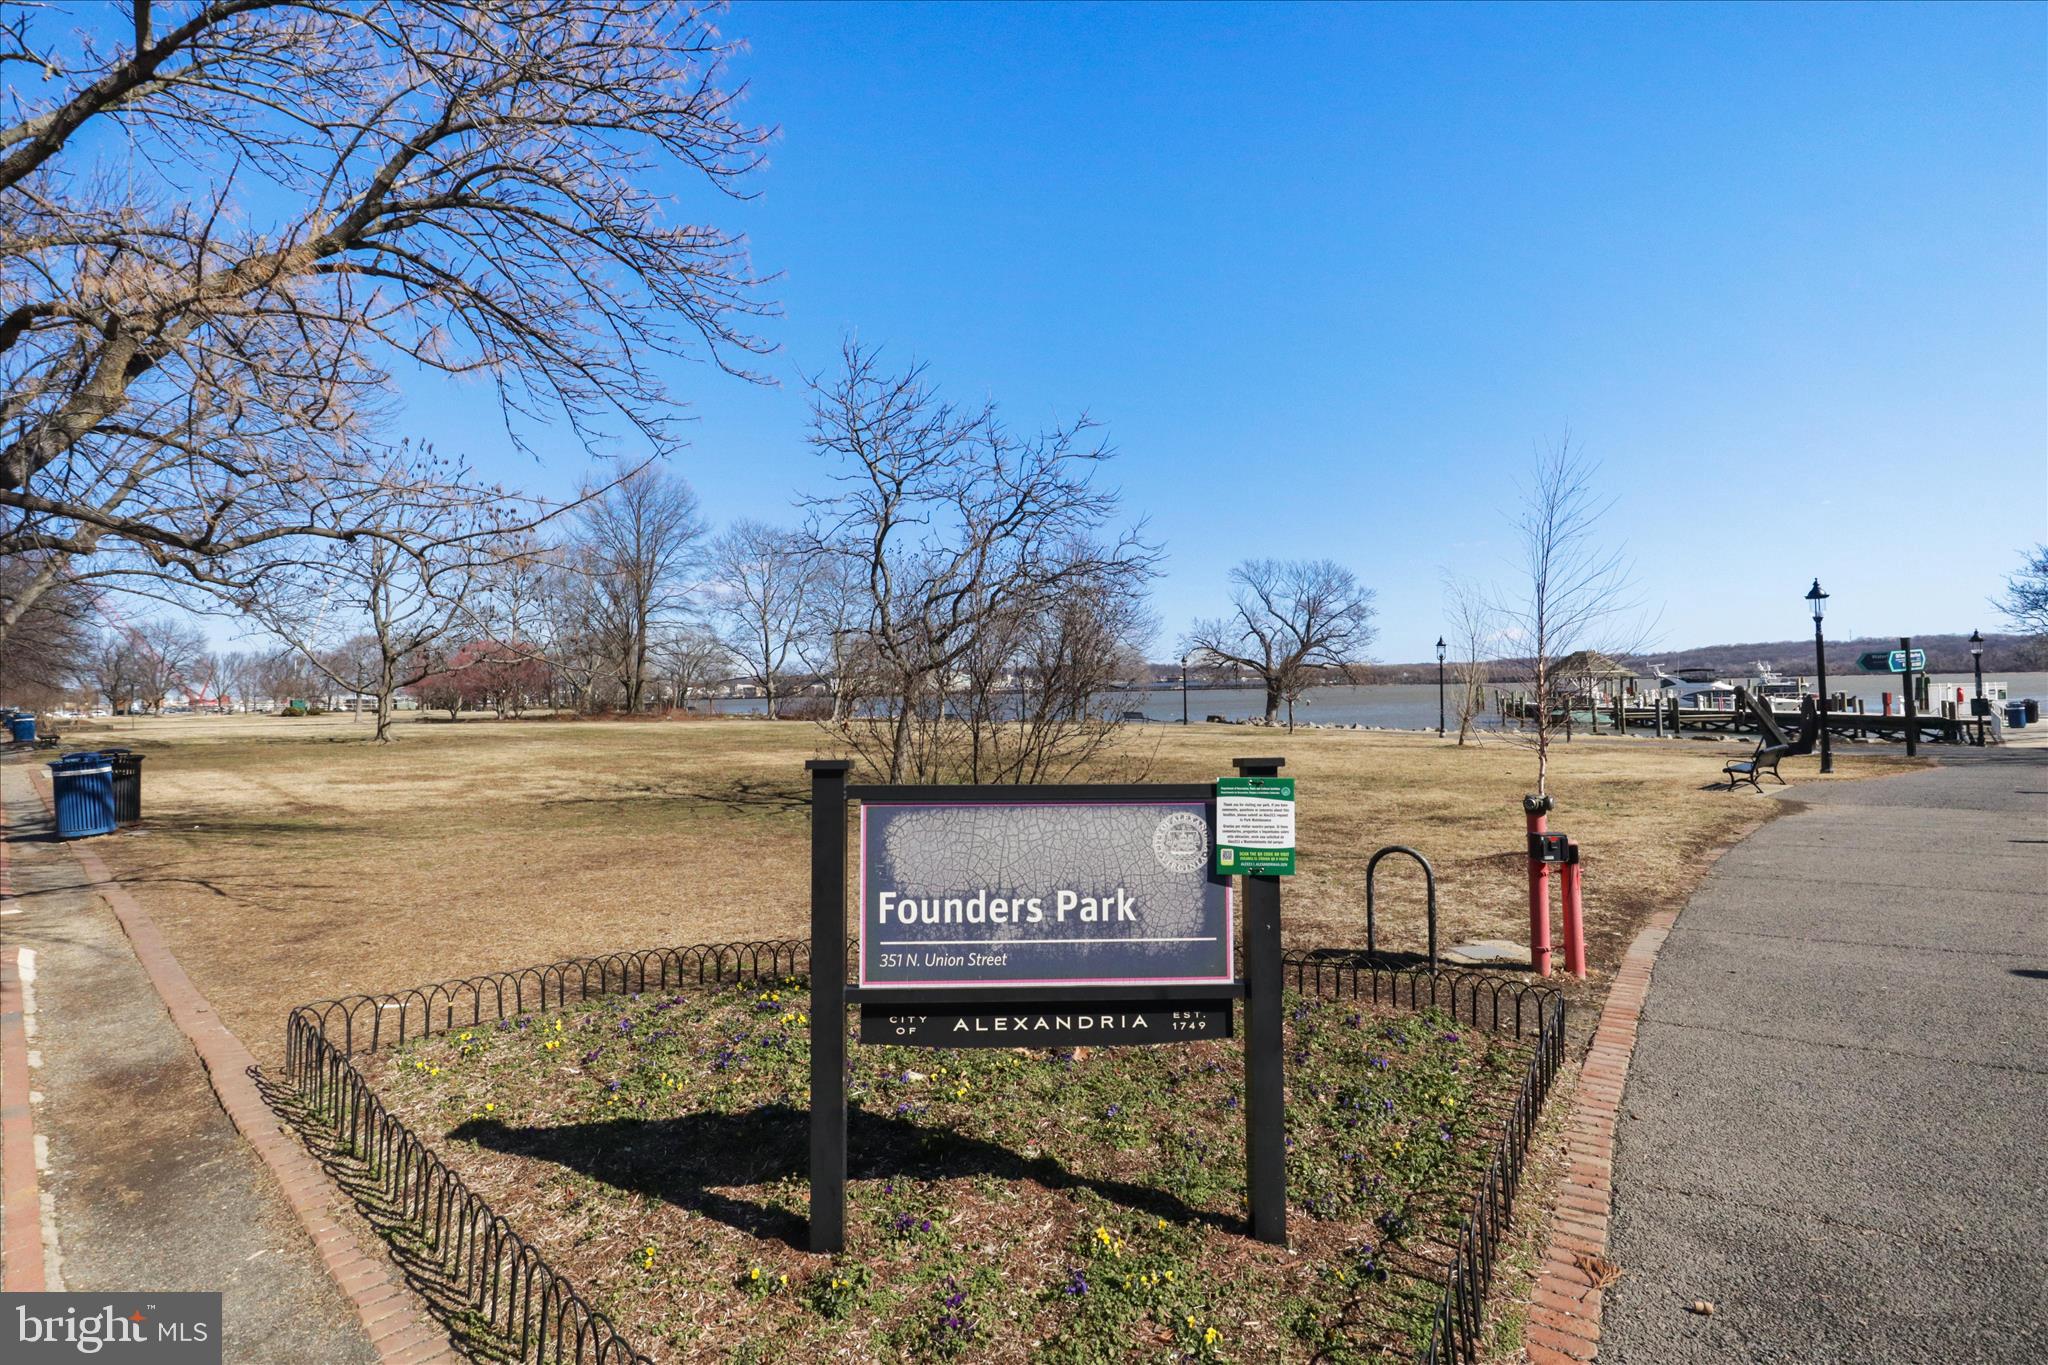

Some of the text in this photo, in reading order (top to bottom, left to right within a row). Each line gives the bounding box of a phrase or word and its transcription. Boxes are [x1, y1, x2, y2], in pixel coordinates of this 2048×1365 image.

[879, 888, 1137, 925] Founders Park
[879, 953, 1008, 968] 351 N. Union Street
[890, 1016, 927, 1024] CITY
[953, 1014, 1148, 1032] ALEXANDRIA
[896, 1027, 916, 1035] OF
[1173, 1022, 1206, 1030] 1749
